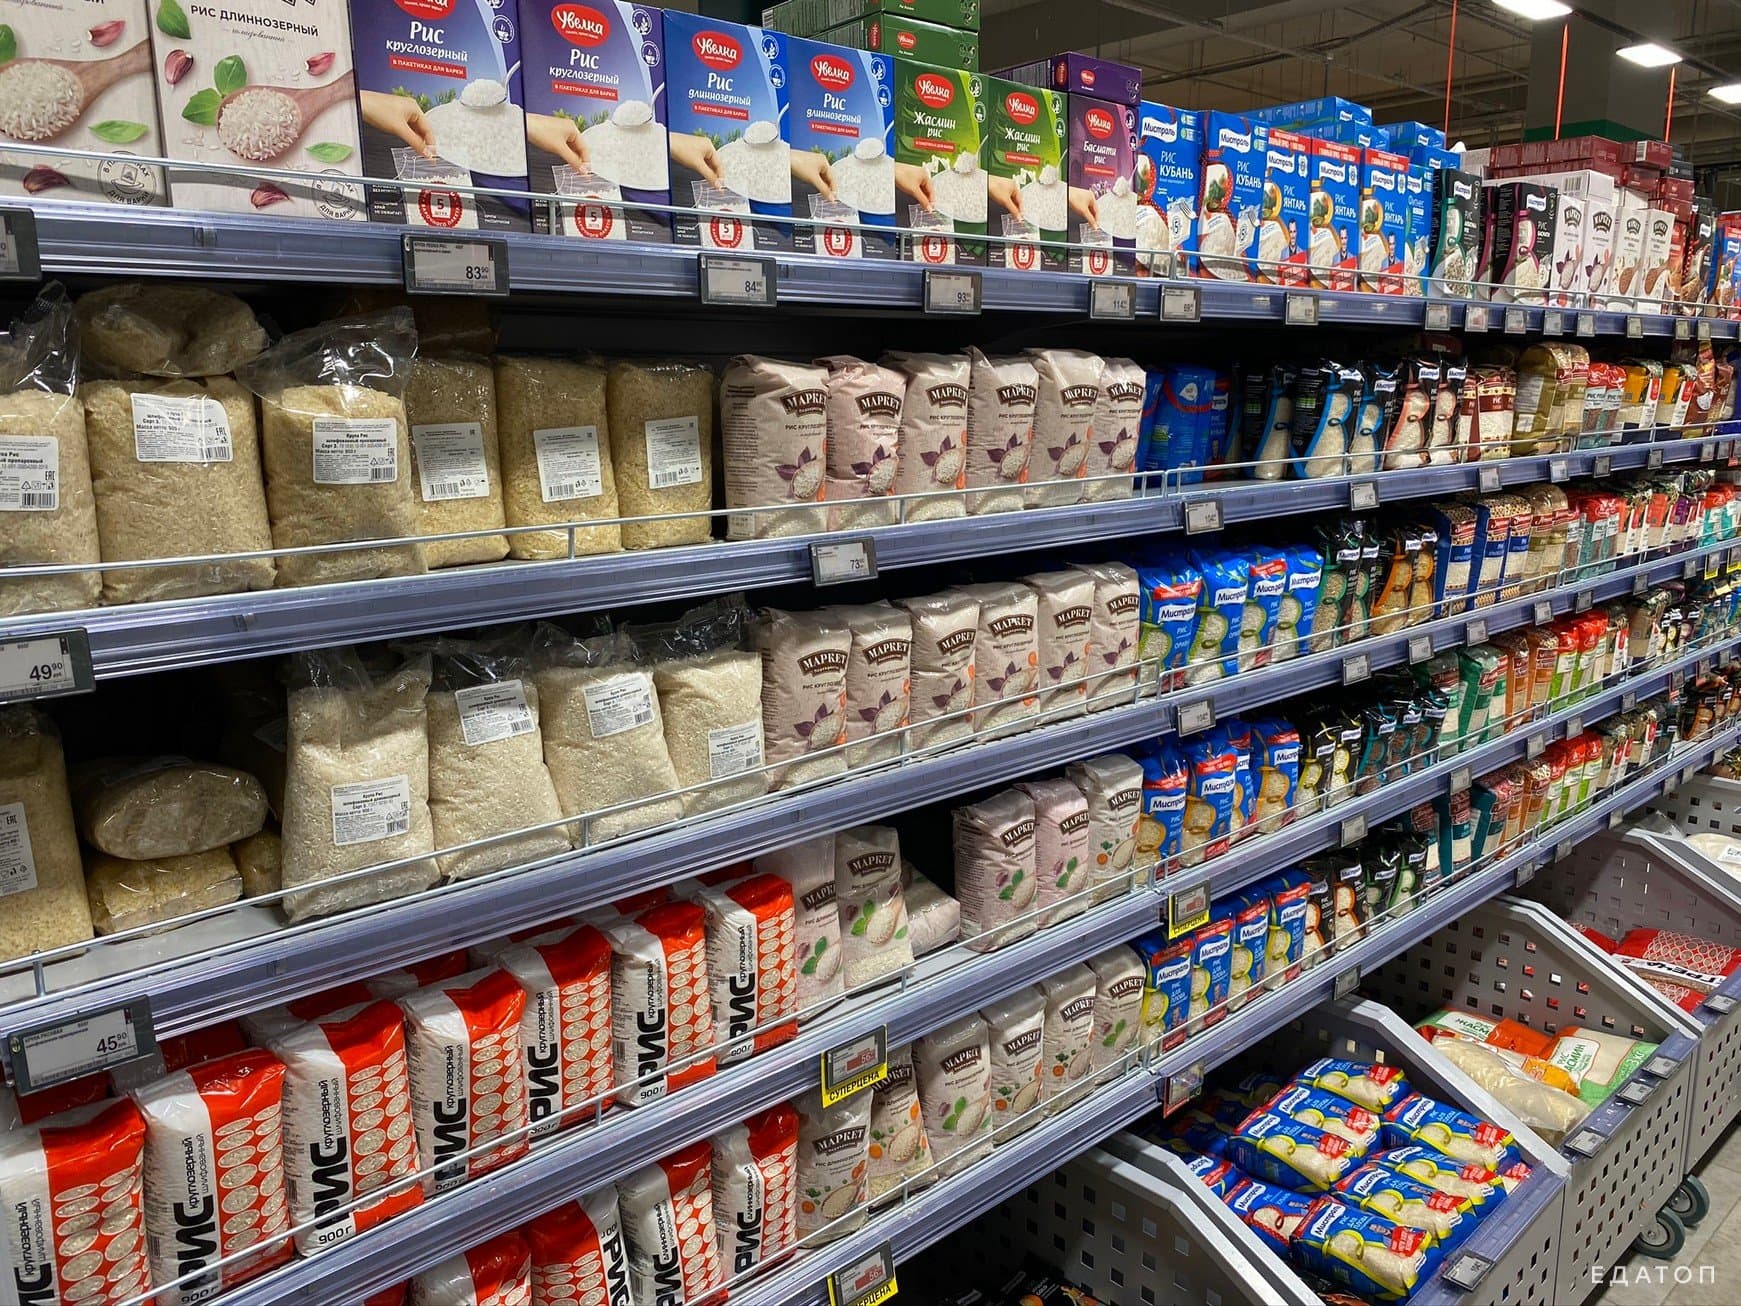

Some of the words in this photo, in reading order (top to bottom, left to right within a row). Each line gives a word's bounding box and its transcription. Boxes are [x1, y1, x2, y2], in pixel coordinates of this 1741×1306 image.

[191, 5, 216, 18] РИС
[219, 9, 319, 37] ДЛИННОЗЕРНЫЙ
[556, 11, 604, 36] Увелка
[410, 21, 445, 44] Рис
[386, 40, 468, 61] круглозерный
[697, 36, 737, 60] Увелка
[398, 60, 432, 70] ПАКЕТИКАХ
[570, 49, 600, 70] Рис
[549, 66, 619, 85] круглозерный
[815, 61, 850, 81] Увелка
[708, 72, 734, 91] Рис
[918, 81, 950, 99] Увелка
[688, 89, 751, 106] длиннозерный
[823, 93, 846, 110] Рис
[1008, 98, 1036, 114] Увелка
[807, 108, 861, 124] длиннозерный
[913, 111, 956, 129] Жасмин
[1087, 116, 1112, 131] Увелка
[927, 127, 943, 138] рис
[1005, 128, 1040, 144] Жасмин
[1143, 121, 1176, 138] Мистраль
[1016, 142, 1030, 153] рис
[1083, 141, 1116, 155] Басмати
[1220, 132, 1250, 148] Мистраль
[1094, 155, 1106, 165] рис
[1161, 152, 1176, 164] РИС
[1267, 155, 1293, 168] Мистраль
[1160, 166, 1193, 180] КУБАНЬ
[1237, 161, 1249, 173] РИС
[1235, 174, 1262, 188] КУБАНЬ
[1284, 185, 1295, 195] РИС
[1283, 197, 1306, 211] ЯНТАРЬ
[1335, 194, 1346, 204] РИС
[1384, 201, 1395, 211] РИС
[1334, 205, 1356, 217] ЯНТАРЬ
[1384, 211, 1404, 224] ЯНТАРЬ
[466, 266, 481, 279] 83
[745, 281, 756, 293] 84
[957, 292, 966, 303] 93
[861, 395, 900, 410] МАРКЕТ
[850, 560, 860, 569] 73
[1058, 608, 1091, 623] МАРКЕТ
[992, 616, 1032, 633] МАРКЕТ
[942, 631, 974, 649] МАРКЕТ
[868, 641, 908, 658] МАРКЕТ
[803, 653, 846, 671] МАРКЕТ
[30, 665, 52, 681] 49
[52, 662, 63, 670] 90
[853, 854, 894, 871] МАРКЕТ
[1112, 978, 1144, 995] МАРКЕТ
[729, 972, 755, 1045] РИС
[537, 992, 548, 1053] круглозерный
[97, 1036, 118, 1053] 45
[117, 1032, 127, 1040] 90
[637, 1008, 665, 1086] РИС
[1557, 1051, 1570, 1065] РИС
[445, 1045, 456, 1109] круглозерный
[527, 1043, 560, 1123] РИС
[830, 1070, 880, 1101] СУПЕРЦЕНА
[640, 1088, 659, 1099] 900
[319, 1079, 333, 1150] круглозерный
[434, 1098, 467, 1182] РИС
[818, 1128, 864, 1151] МАРКЕТ
[183, 1137, 198, 1210] круглозерный
[310, 1137, 350, 1230] РИС
[20, 1201, 34, 1276] круглозерный
[174, 1195, 218, 1292] РИС
[319, 1228, 343, 1244] 900
[735, 1208, 762, 1275] РИС
